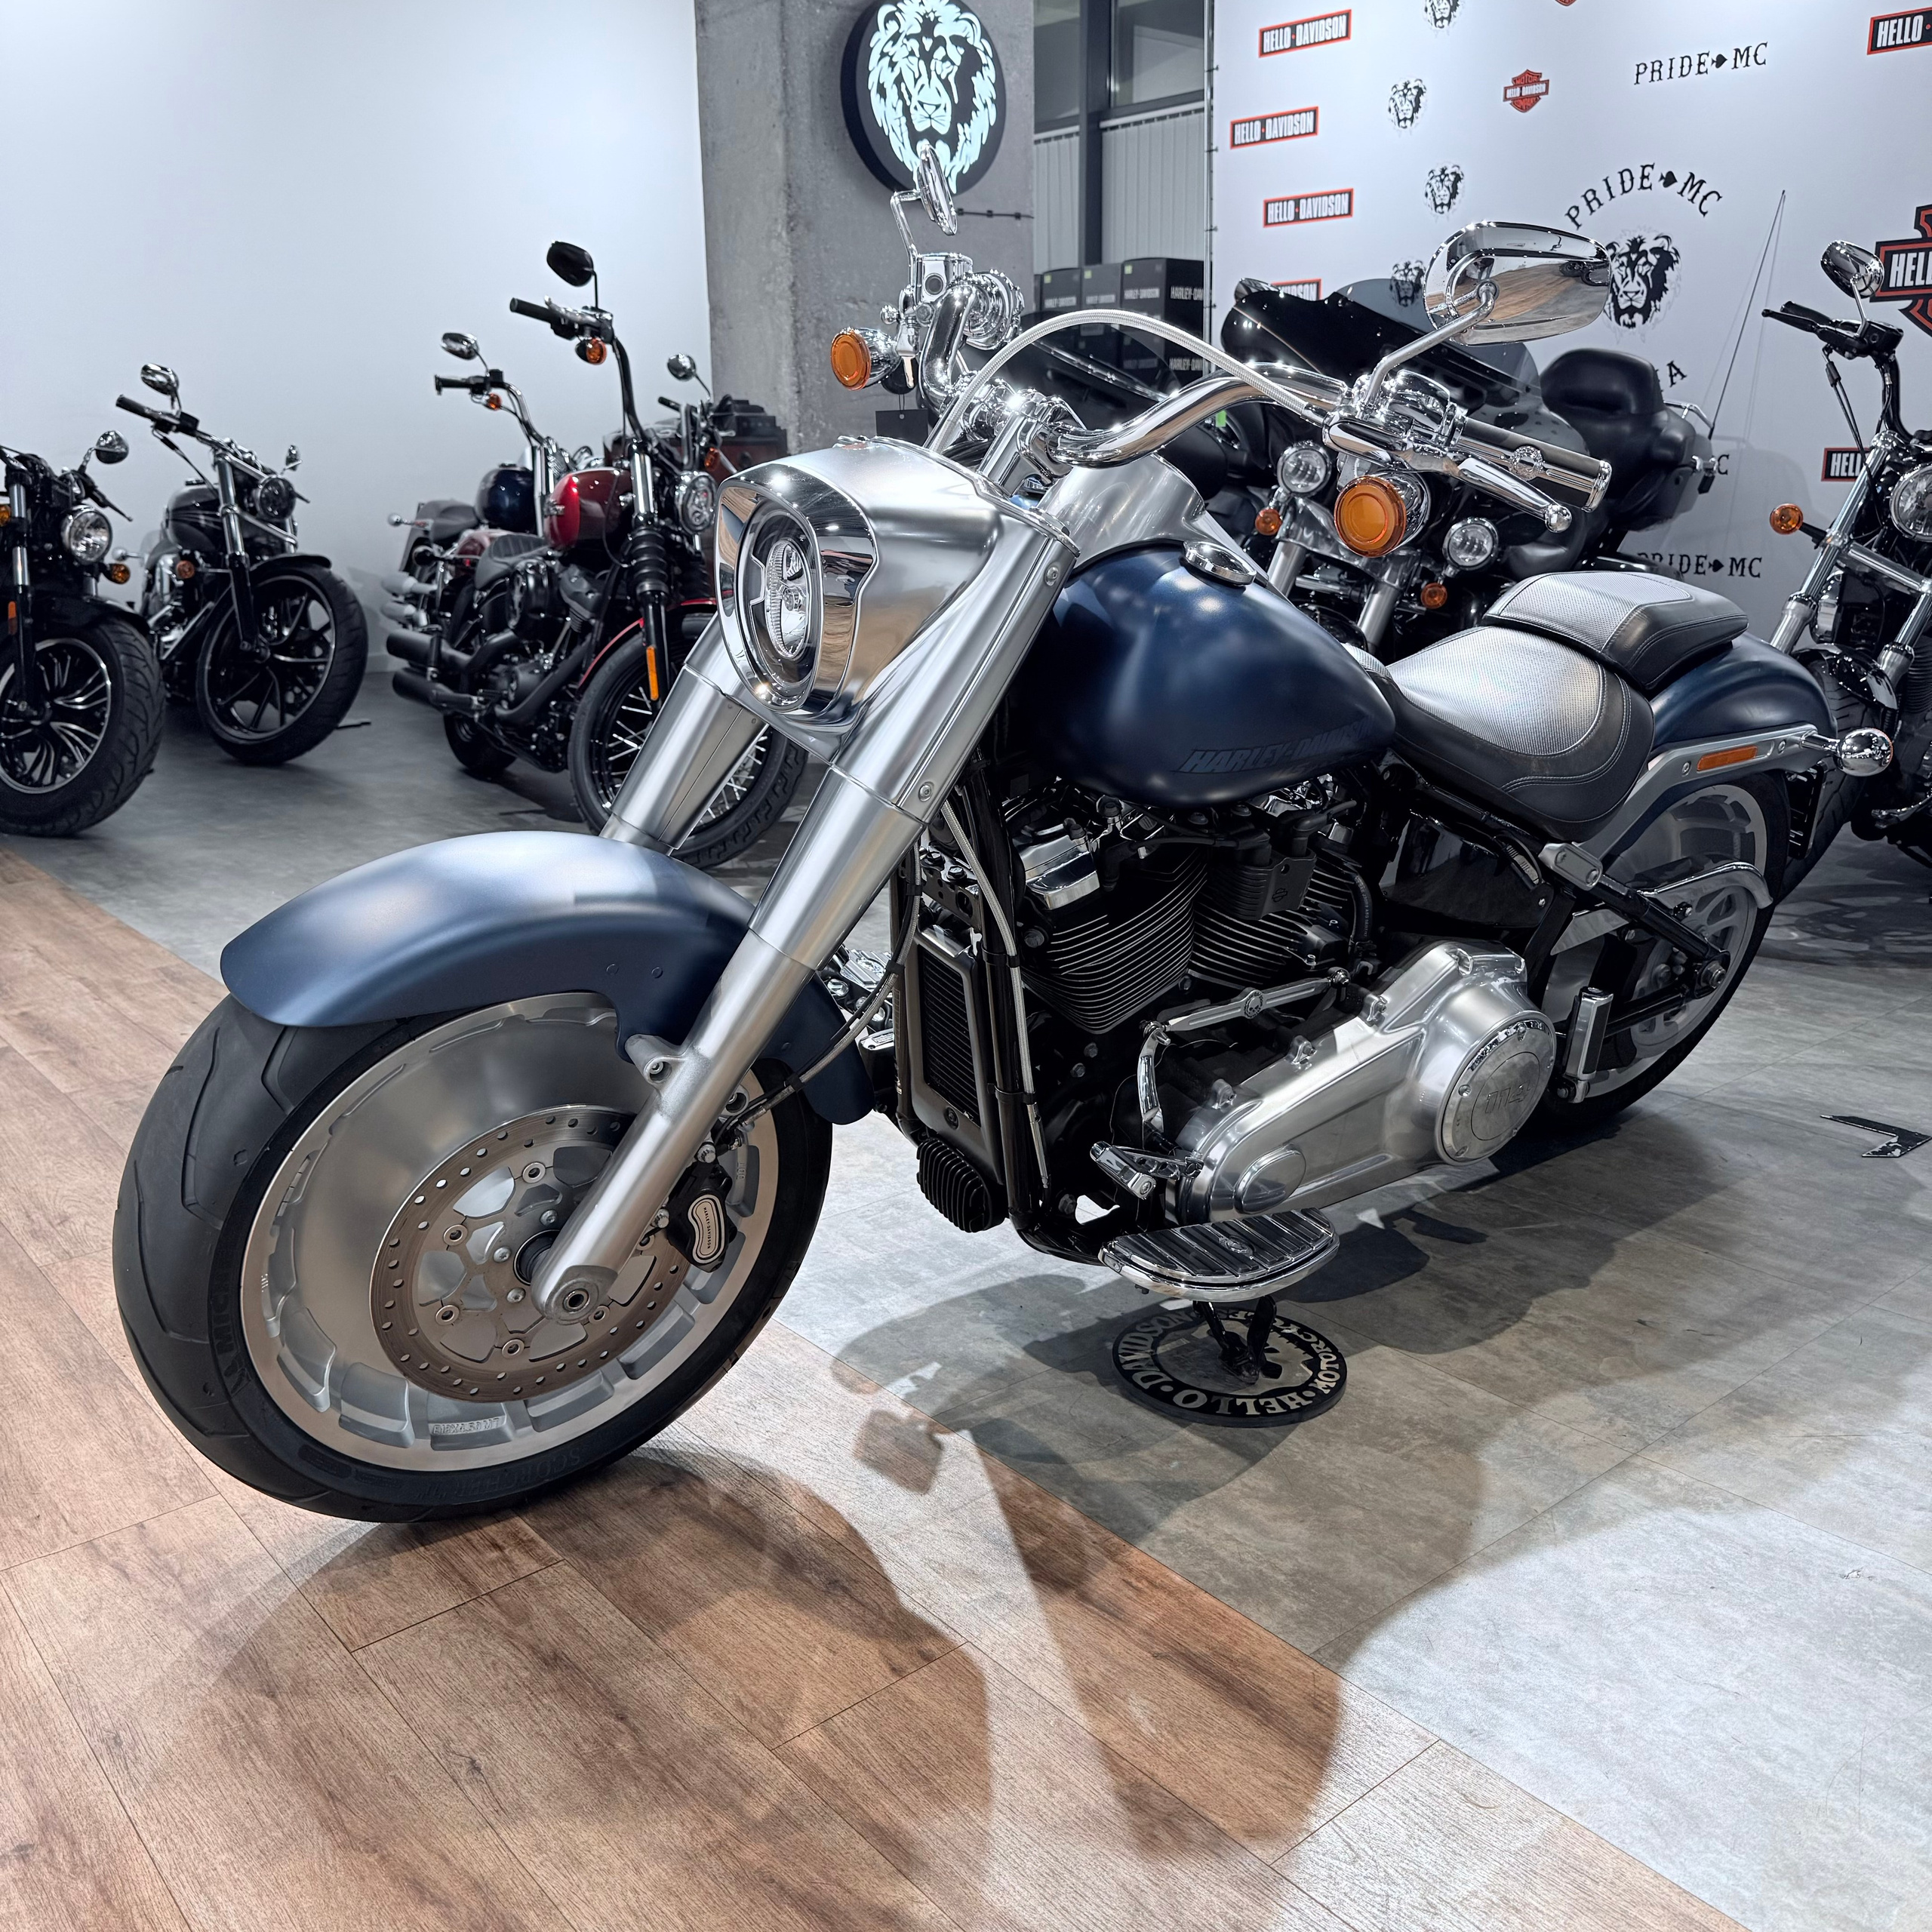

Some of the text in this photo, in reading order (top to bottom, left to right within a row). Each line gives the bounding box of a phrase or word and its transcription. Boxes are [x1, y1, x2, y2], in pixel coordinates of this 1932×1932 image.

[1263, 14, 1347, 53] HELLO DAVIDSON
[1876, 15, 1924, 48] HELLO
[1633, 42, 1768, 85] PRIDE MC
[1234, 111, 1315, 146] HELLO DAVIDSON
[1267, 192, 1349, 224] HELLO DAVIDSON
[1564, 162, 1723, 230] PRIDE MC
[1830, 453, 1869, 476] HELL
[1727, 556, 1762, 579] MC
[1172, 1389, 1313, 1416] HELLO
